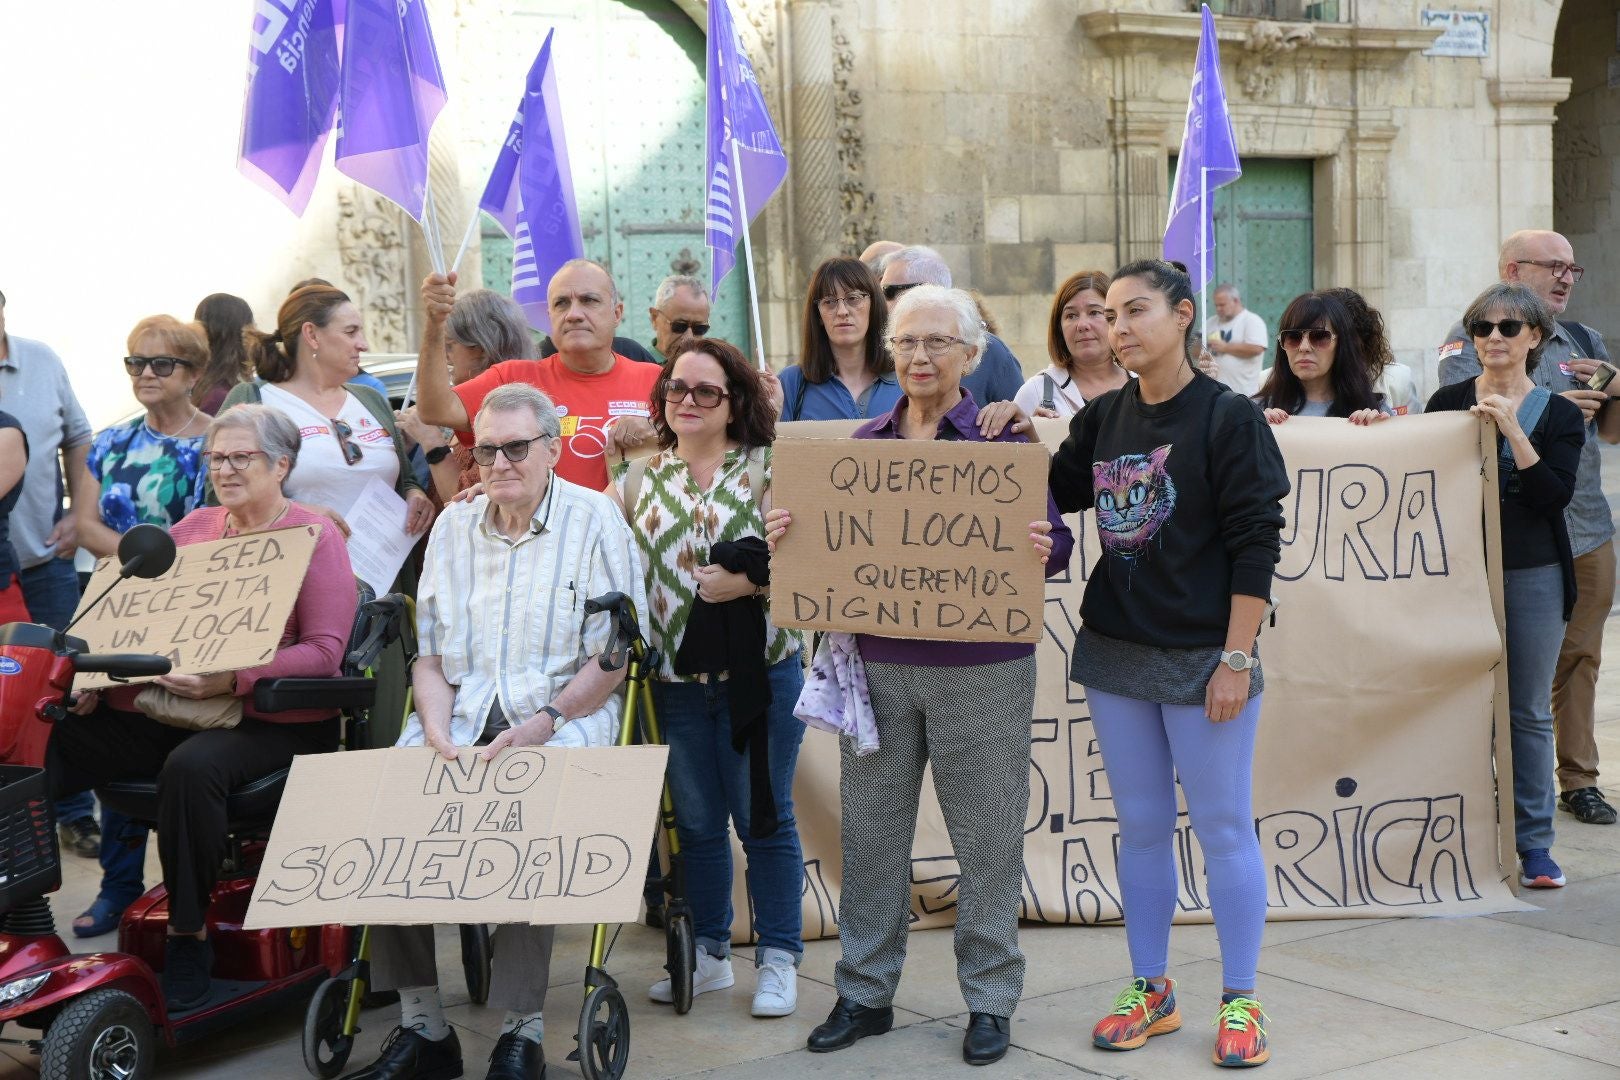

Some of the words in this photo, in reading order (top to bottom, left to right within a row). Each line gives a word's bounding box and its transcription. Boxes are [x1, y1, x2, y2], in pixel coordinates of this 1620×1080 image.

[830, 456, 1022, 503] QUEREMOS
[824, 509, 875, 552] UN
[901, 508, 1015, 551] LOCAL
[206, 538, 285, 571] S.E.D.
[96, 574, 272, 621] NECESITA
[854, 563, 1018, 598] QUEREMOS
[111, 626, 149, 649] UN
[170, 602, 272, 644] LOCAL
[422, 750, 546, 796] NO
[428, 801, 464, 836] A
[472, 799, 523, 833] LA
[256, 834, 632, 906] SOLEDAD
